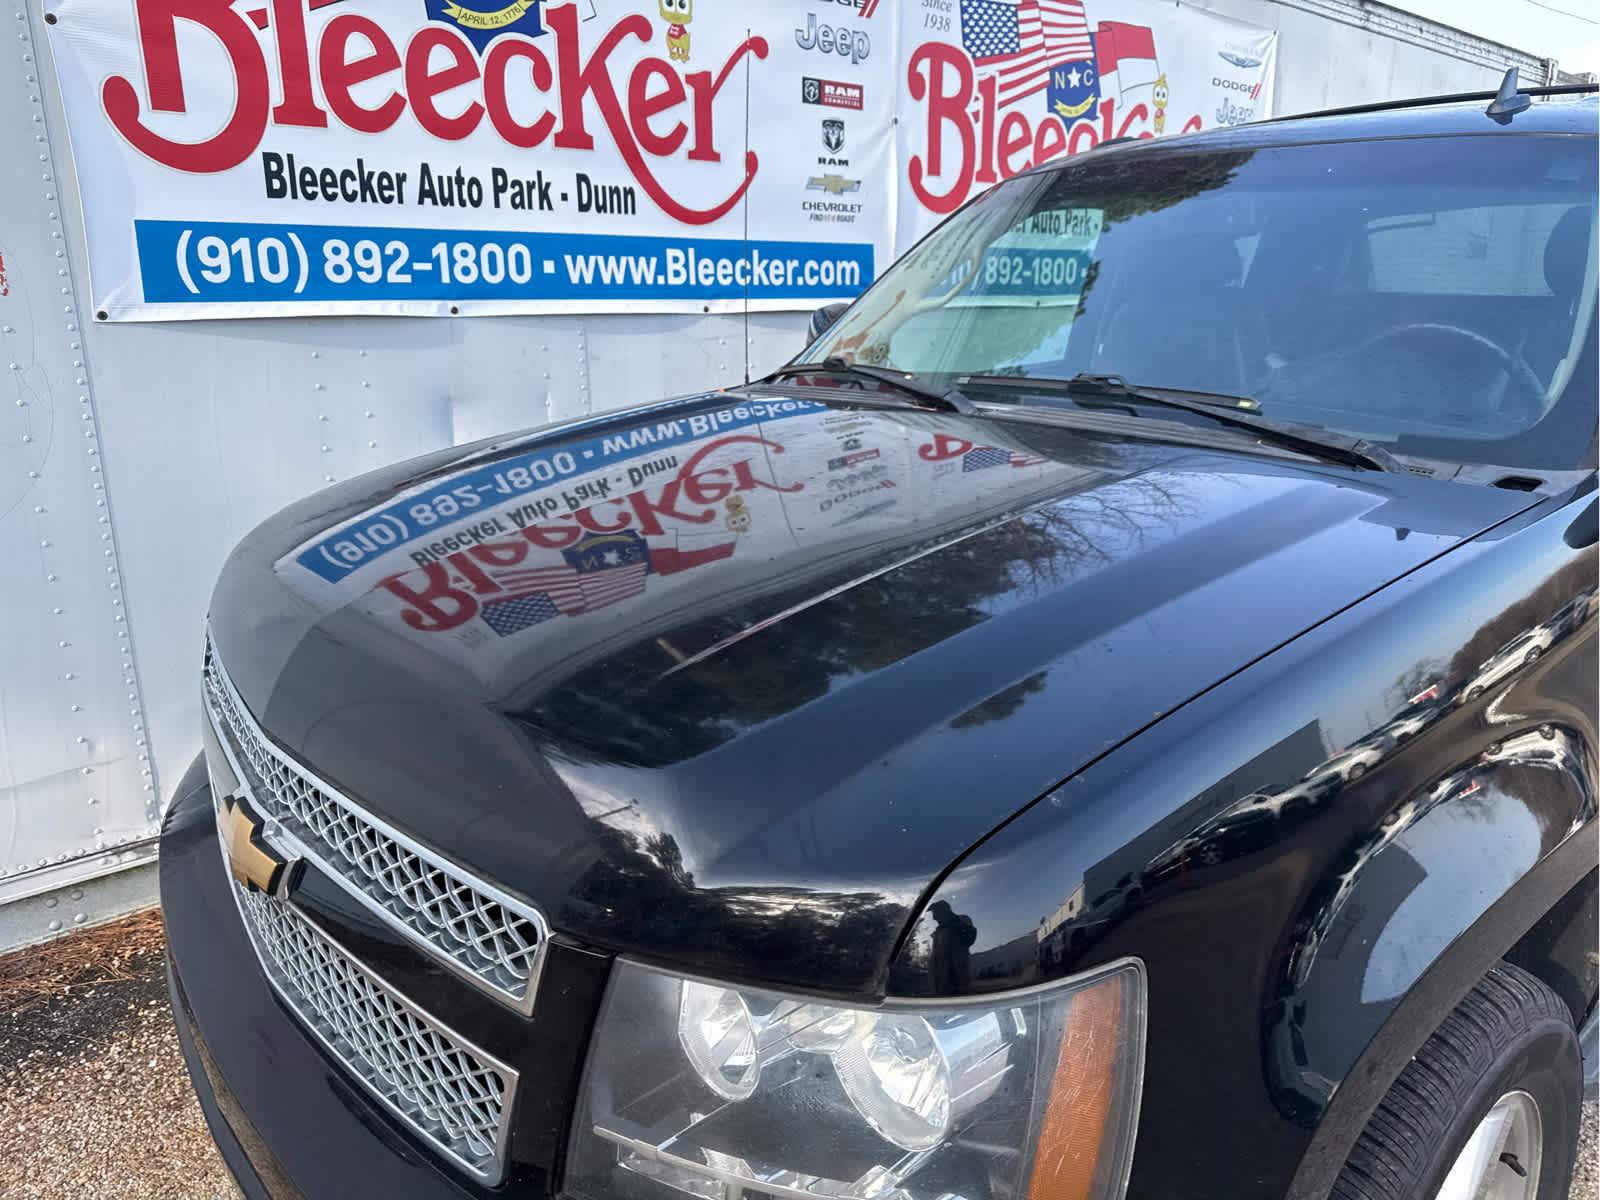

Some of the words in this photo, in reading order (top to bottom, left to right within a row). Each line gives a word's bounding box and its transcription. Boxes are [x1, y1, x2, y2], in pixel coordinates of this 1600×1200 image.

[461, 13, 488, 26] APRIL
[504, 7, 521, 21] 1776
[923, 13, 952, 32] 1938
[795, 13, 871, 64] Jeep
[1055, 71, 1065, 89] N
[1083, 69, 1094, 86] C
[1212, 77, 1255, 94] DODGE
[825, 85, 860, 98] RAM
[103, 0, 768, 225] Bleecker
[908, 41, 1202, 214] Blee
[817, 157, 849, 167] RAM
[261, 151, 407, 205] Bleecker
[418, 163, 483, 208] Auto
[492, 167, 554, 211] Park
[576, 172, 637, 215] Dunn
[801, 201, 863, 213] CHEVROLET
[1031, 210, 1060, 235] Auto
[1064, 207, 1093, 236] Park
[176, 230, 309, 294] (910)
[322, 238, 532, 285] 892-1800
[564, 247, 860, 287] www.Bleecker.com
[985, 255, 1078, 286] 892-1800
